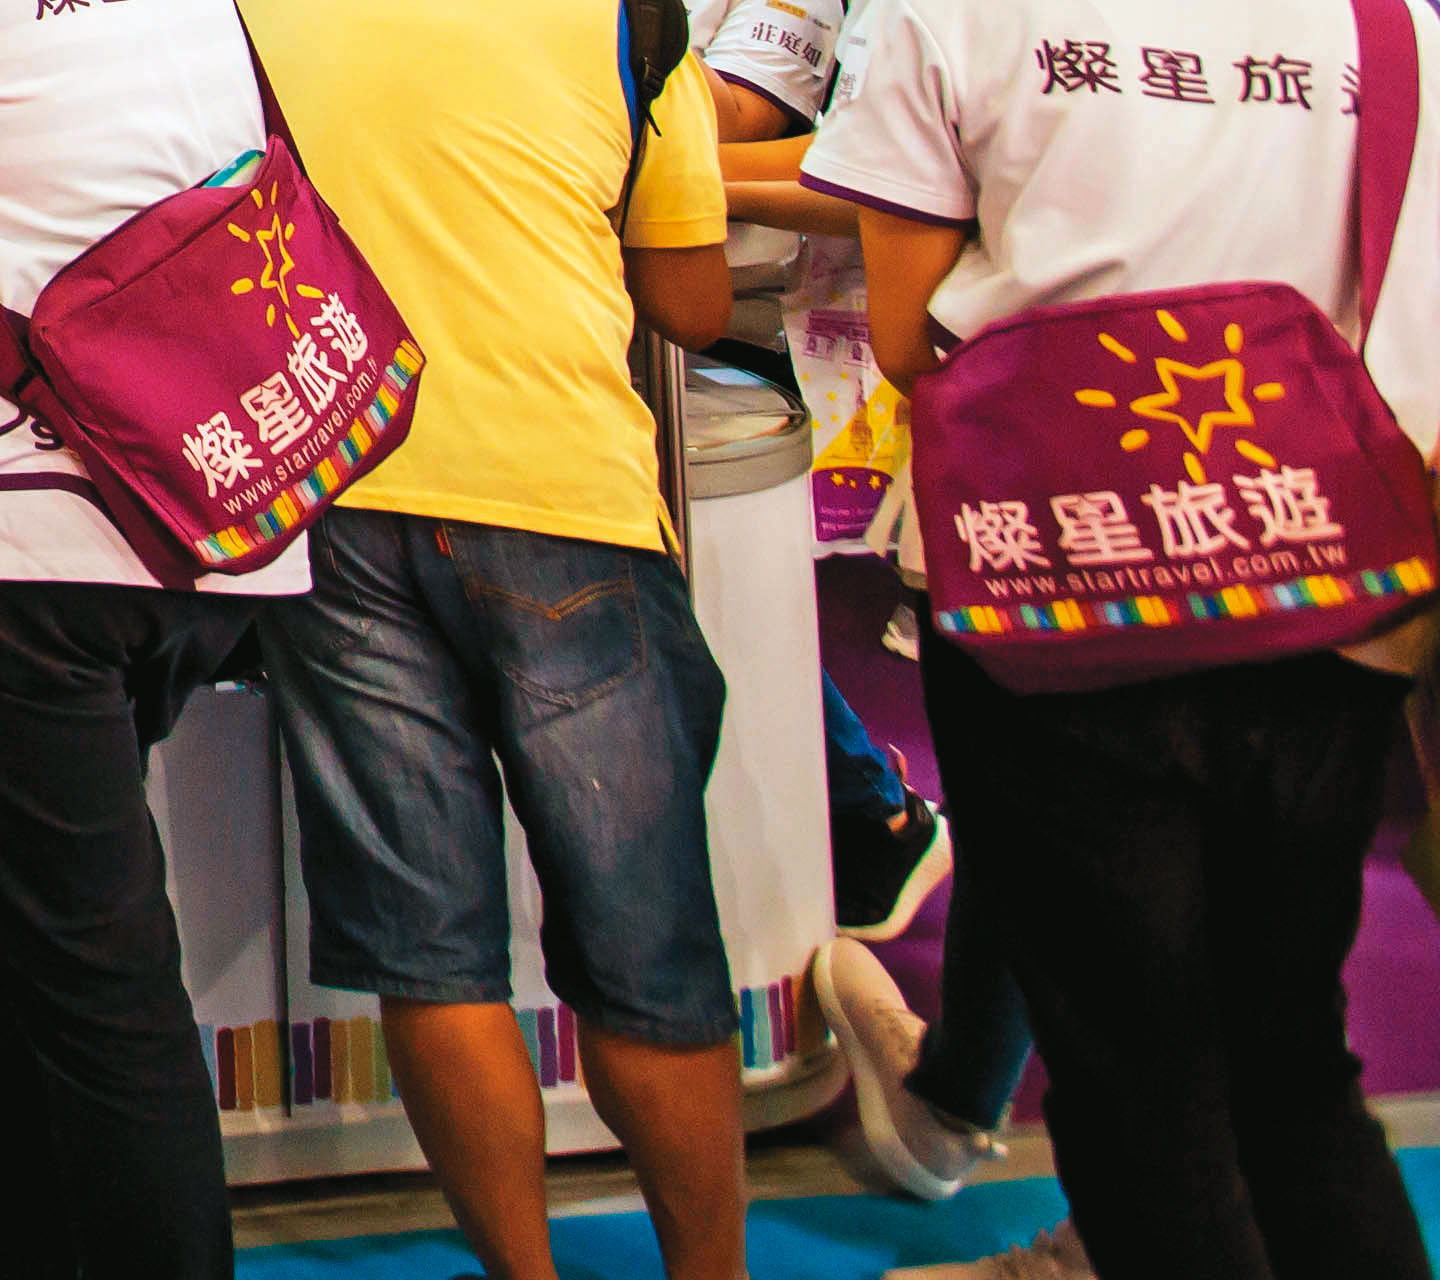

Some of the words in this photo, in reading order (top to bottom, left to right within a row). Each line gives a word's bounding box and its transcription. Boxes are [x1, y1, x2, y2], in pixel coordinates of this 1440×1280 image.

[182, 290, 371, 500] 燦星旅遊
[953, 464, 1347, 579] 燦星旅遊
[983, 544, 1348, 600] www.startravel.com.tw
